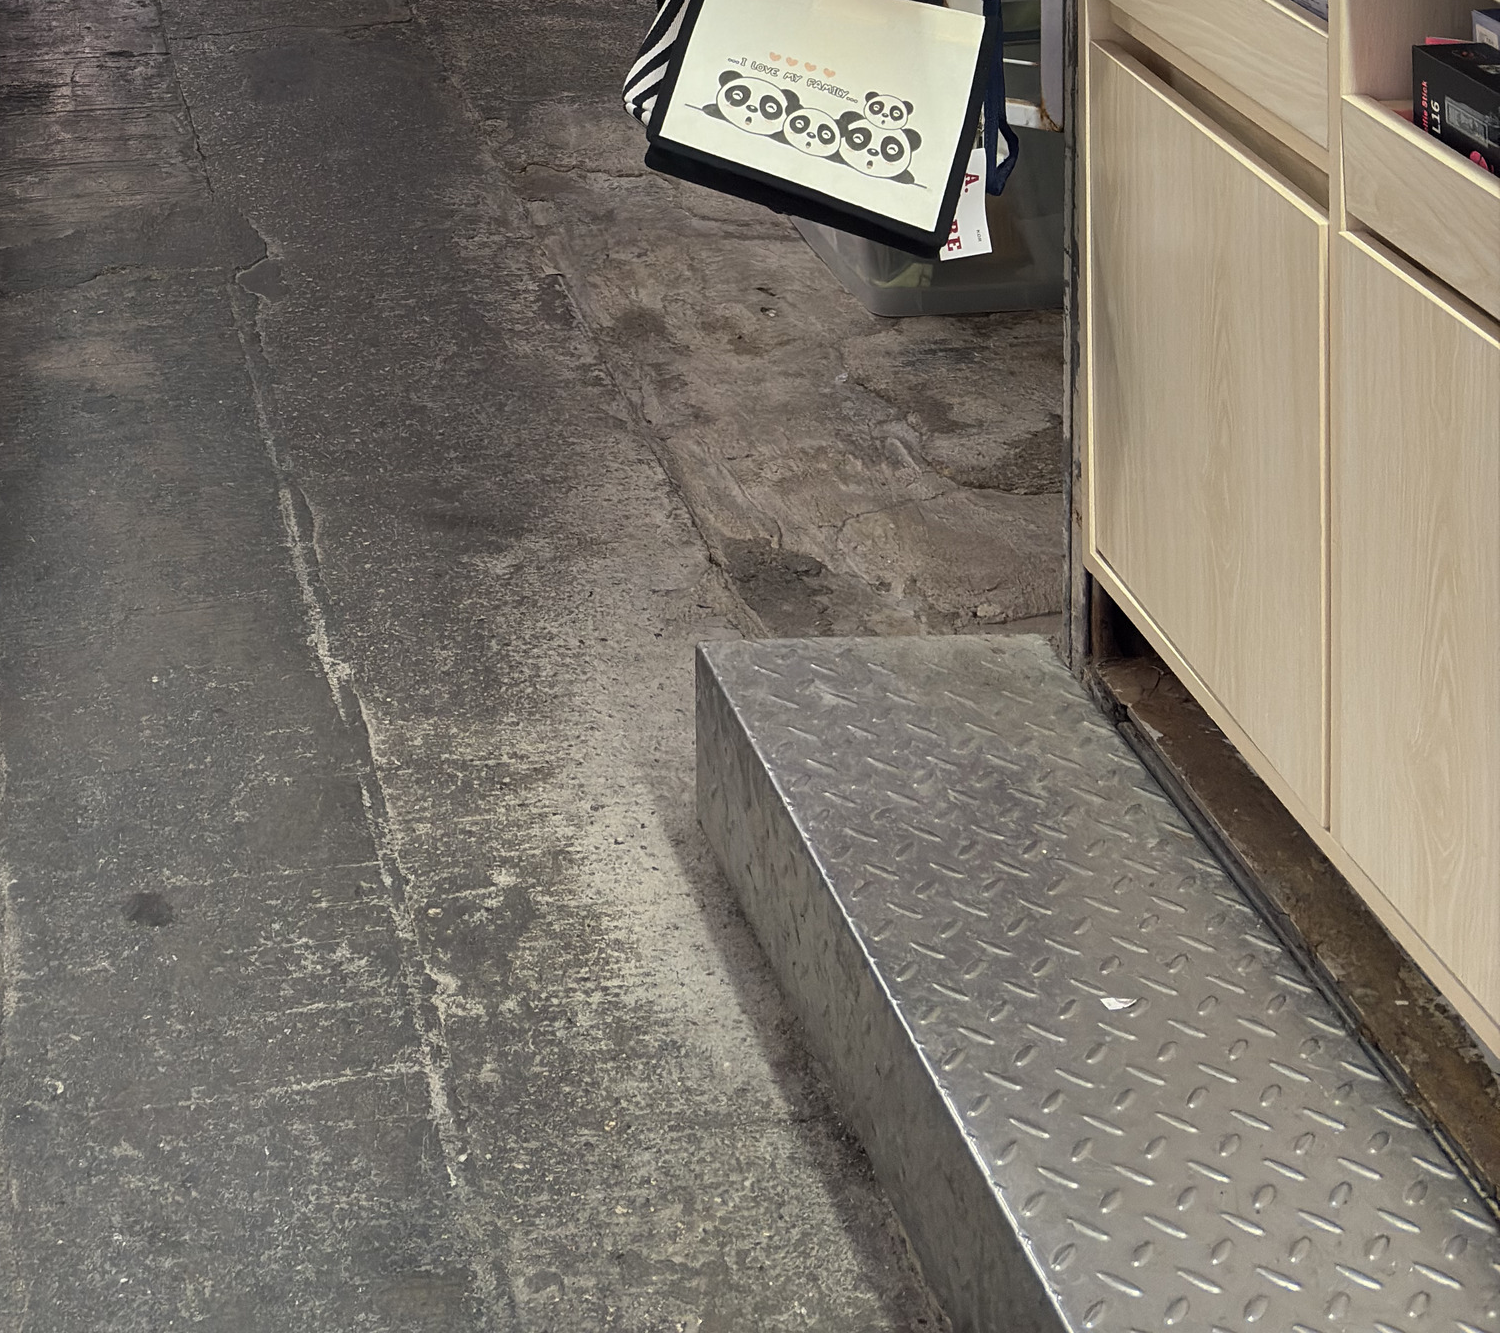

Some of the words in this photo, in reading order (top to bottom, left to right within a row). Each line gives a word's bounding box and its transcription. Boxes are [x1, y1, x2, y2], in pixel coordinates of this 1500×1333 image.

[750, 60, 780, 77] LOVE
[783, 71, 803, 83] MY
[1430, 99, 1441, 134] L16
